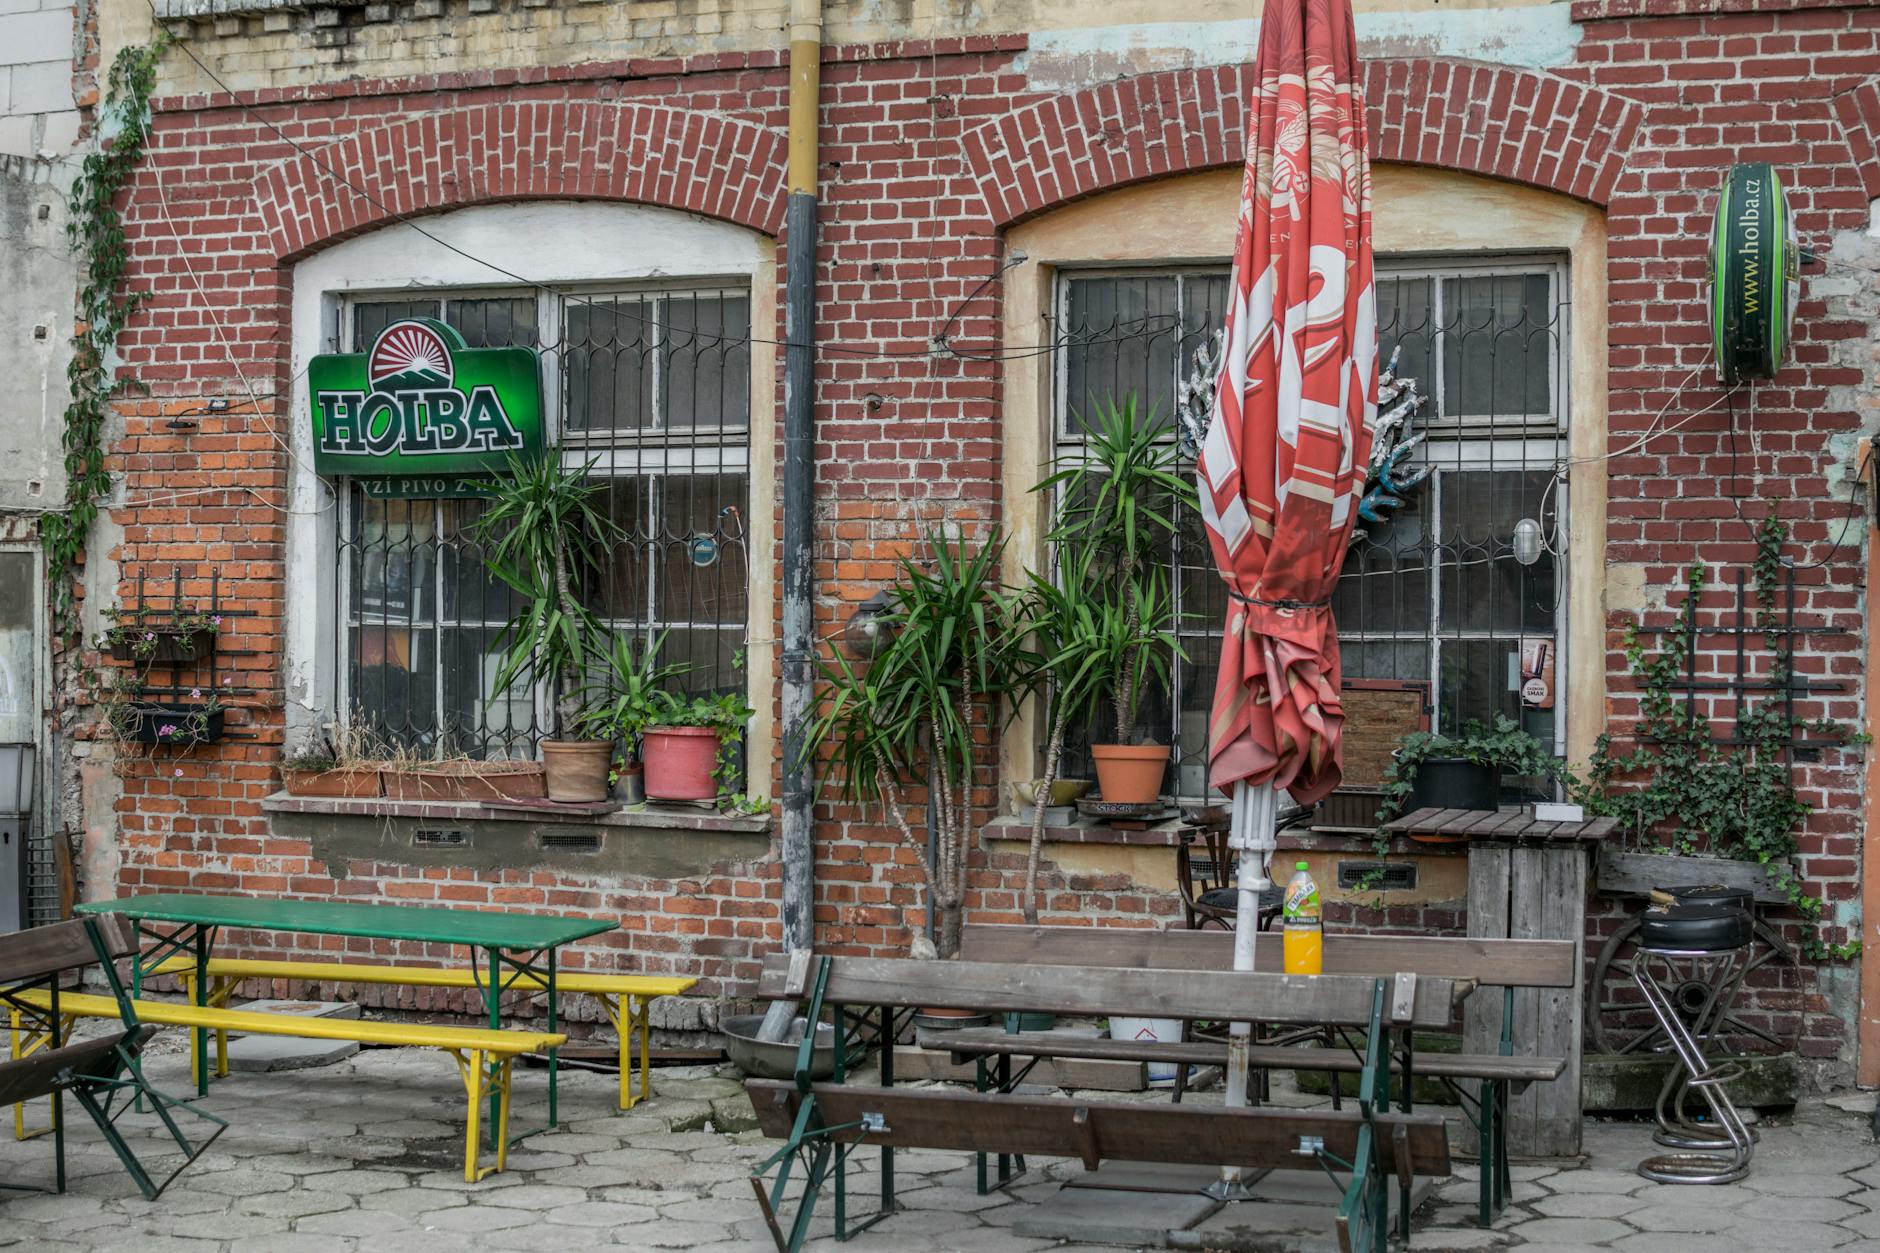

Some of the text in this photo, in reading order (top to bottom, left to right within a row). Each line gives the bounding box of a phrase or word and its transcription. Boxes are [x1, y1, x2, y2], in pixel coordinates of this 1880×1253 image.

[1738, 179, 1761, 315] www.holba.cz
[317, 384, 524, 456] HOLBA
[401, 478, 446, 493] PIVO
[455, 478, 467, 492] Z
[1096, 803, 1132, 814] STOCK
